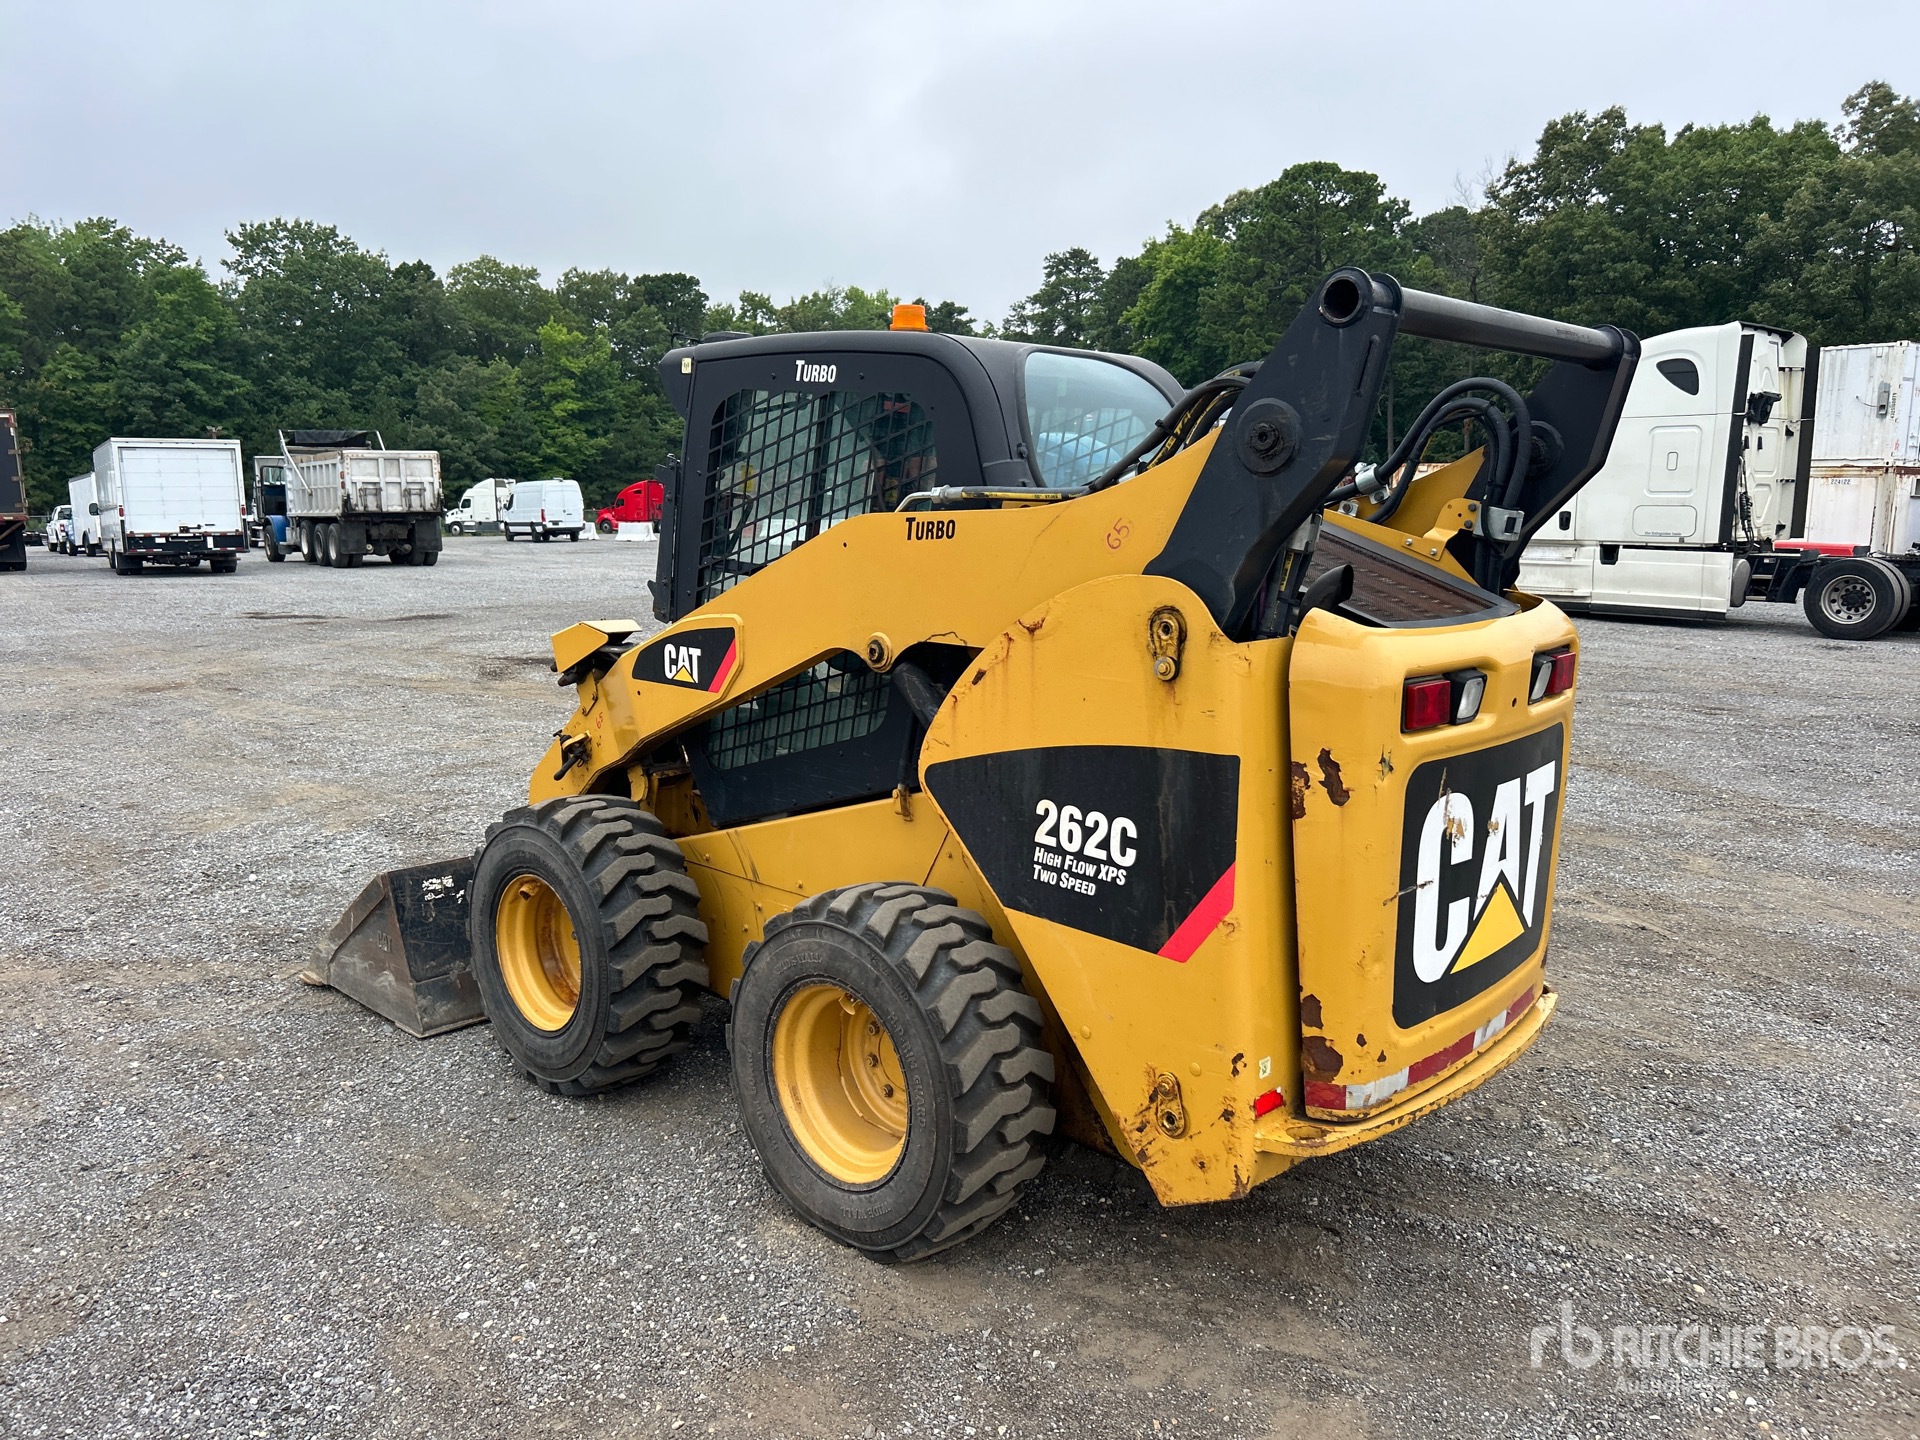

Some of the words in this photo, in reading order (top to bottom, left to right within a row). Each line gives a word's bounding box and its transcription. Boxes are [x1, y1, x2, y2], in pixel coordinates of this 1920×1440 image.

[795, 359, 837, 384] TURBO
[905, 516, 956, 540] TURBO
[1106, 517, 1130, 550] 65
[663, 643, 702, 684] CAT
[1034, 798, 1138, 867] 262C
[1033, 863, 1057, 885] TWO
[1059, 871, 1096, 896] SPEED
[1034, 846, 1062, 868] HIGH
[1064, 854, 1097, 877] FLOW
[1098, 864, 1127, 886] XPS
[1412, 760, 1556, 984] CAT
